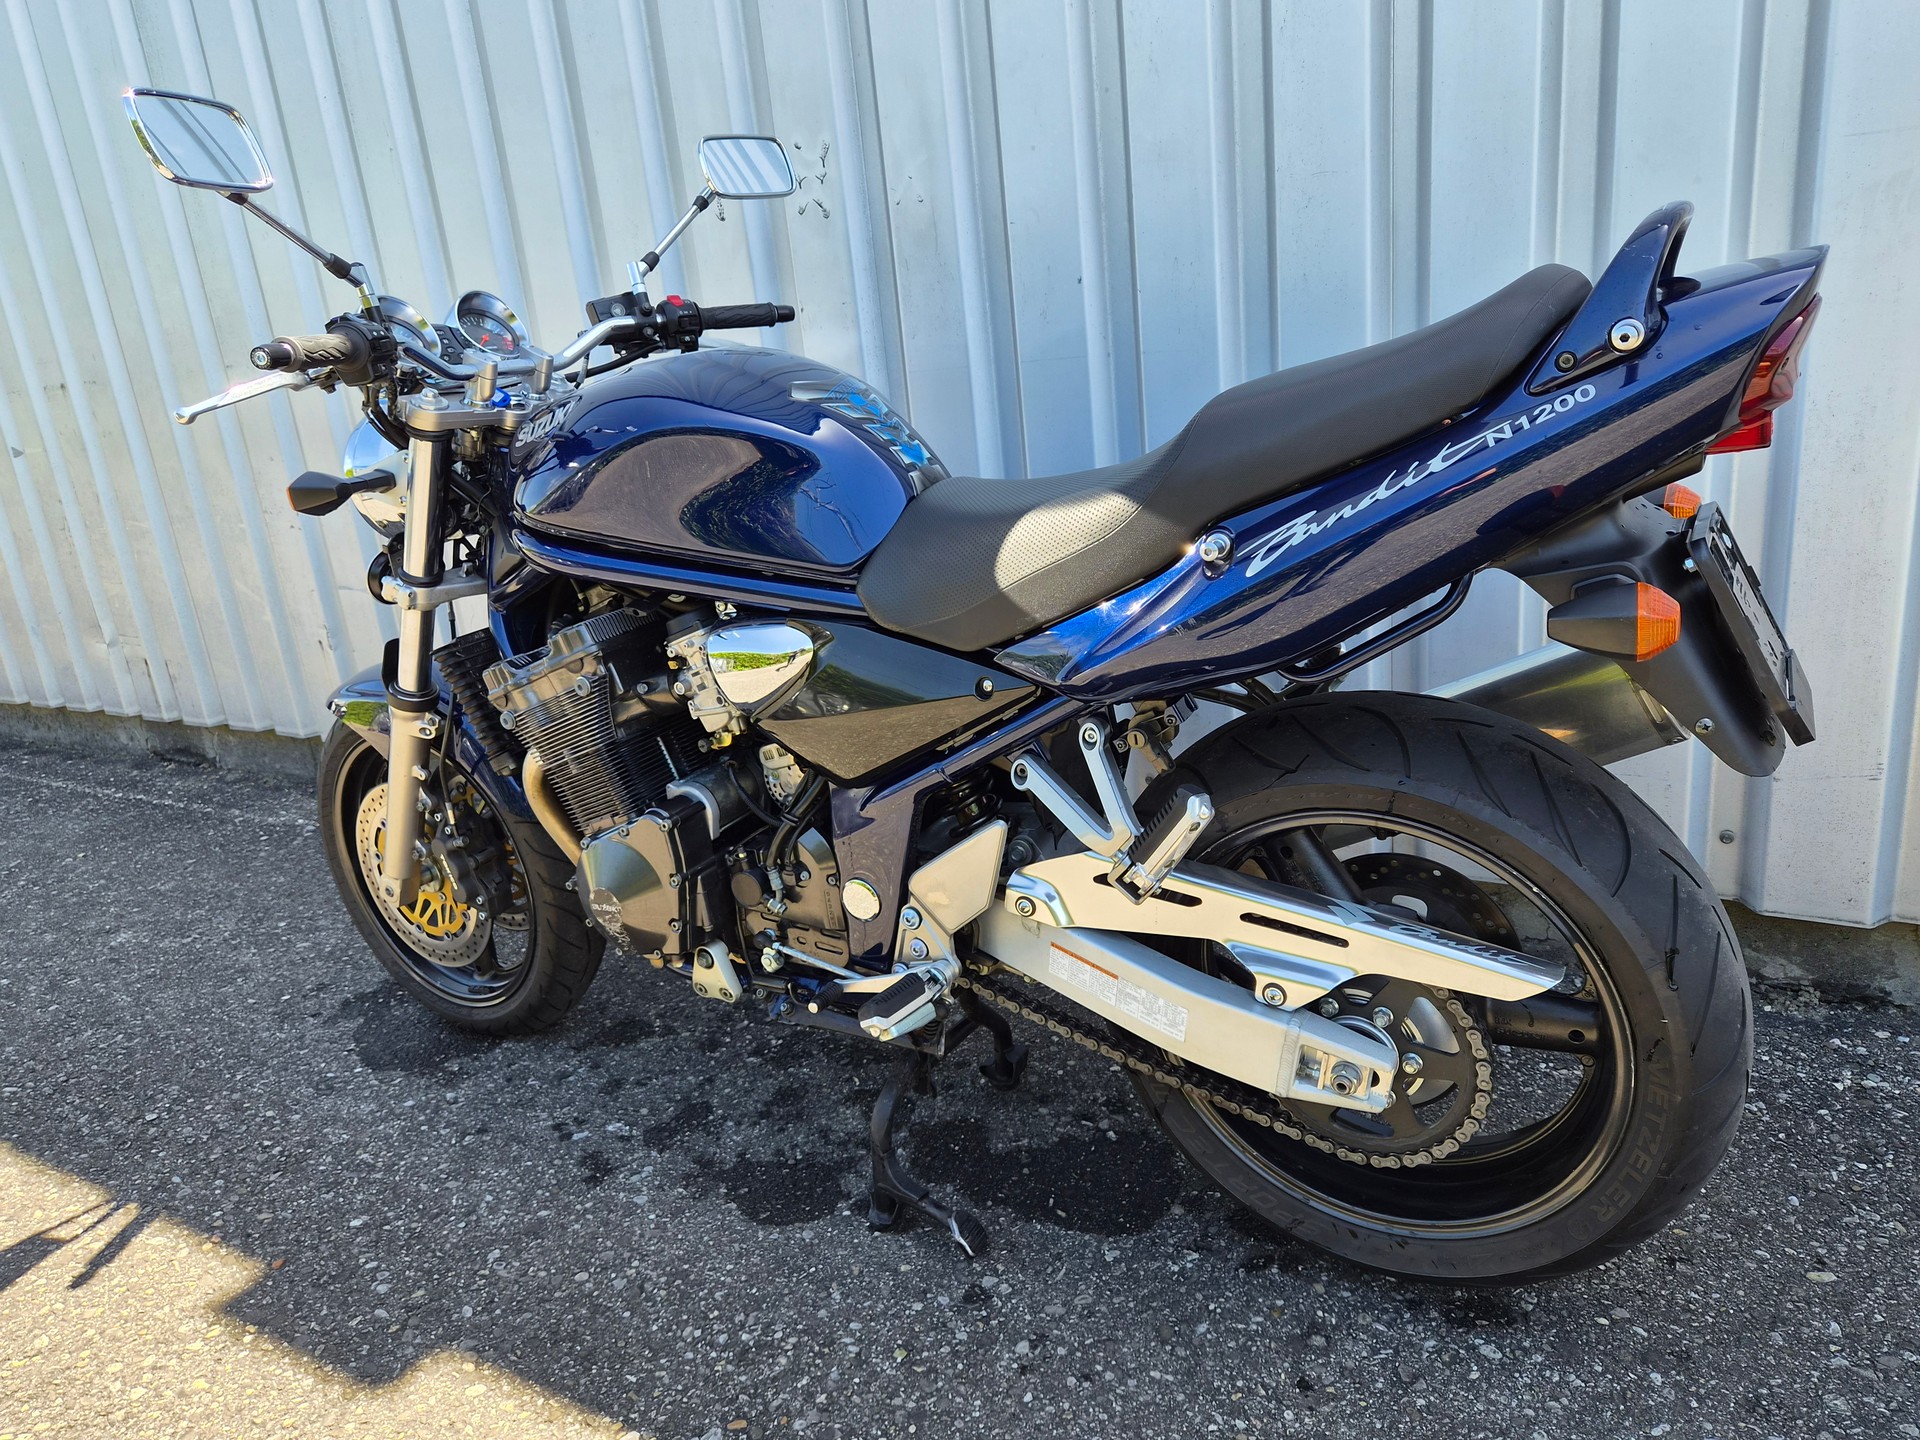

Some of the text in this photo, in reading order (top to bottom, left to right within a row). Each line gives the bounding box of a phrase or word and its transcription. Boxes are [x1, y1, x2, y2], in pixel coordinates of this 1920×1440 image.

[1237, 384, 1597, 577] Bandit N1200
[1388, 918, 1546, 970] Bandit
[1589, 1058, 1674, 1222] METZELER
